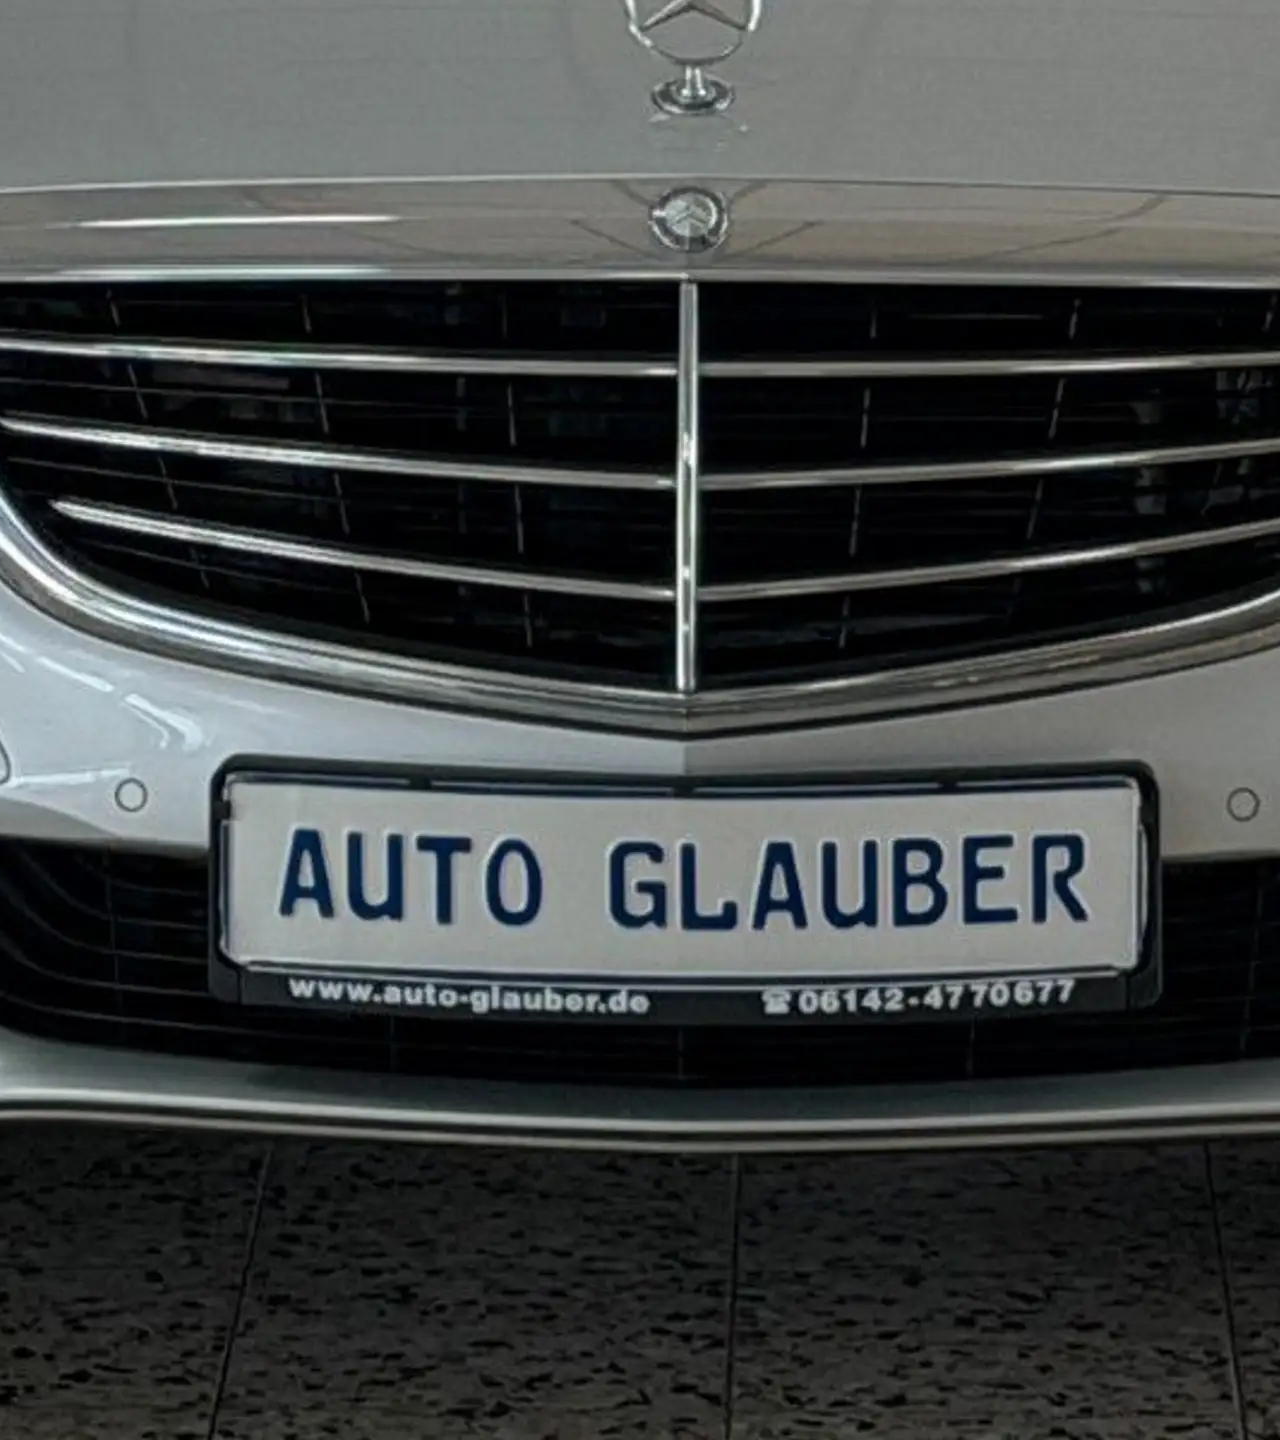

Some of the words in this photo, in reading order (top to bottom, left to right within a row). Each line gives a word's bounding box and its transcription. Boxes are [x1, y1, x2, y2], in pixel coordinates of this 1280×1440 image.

[277, 827, 545, 927] AUTO
[608, 832, 1091, 932] GLAUBER
[288, 978, 651, 1014] www.auto-glauber.de
[797, 979, 1075, 1014] 06142-4770677
